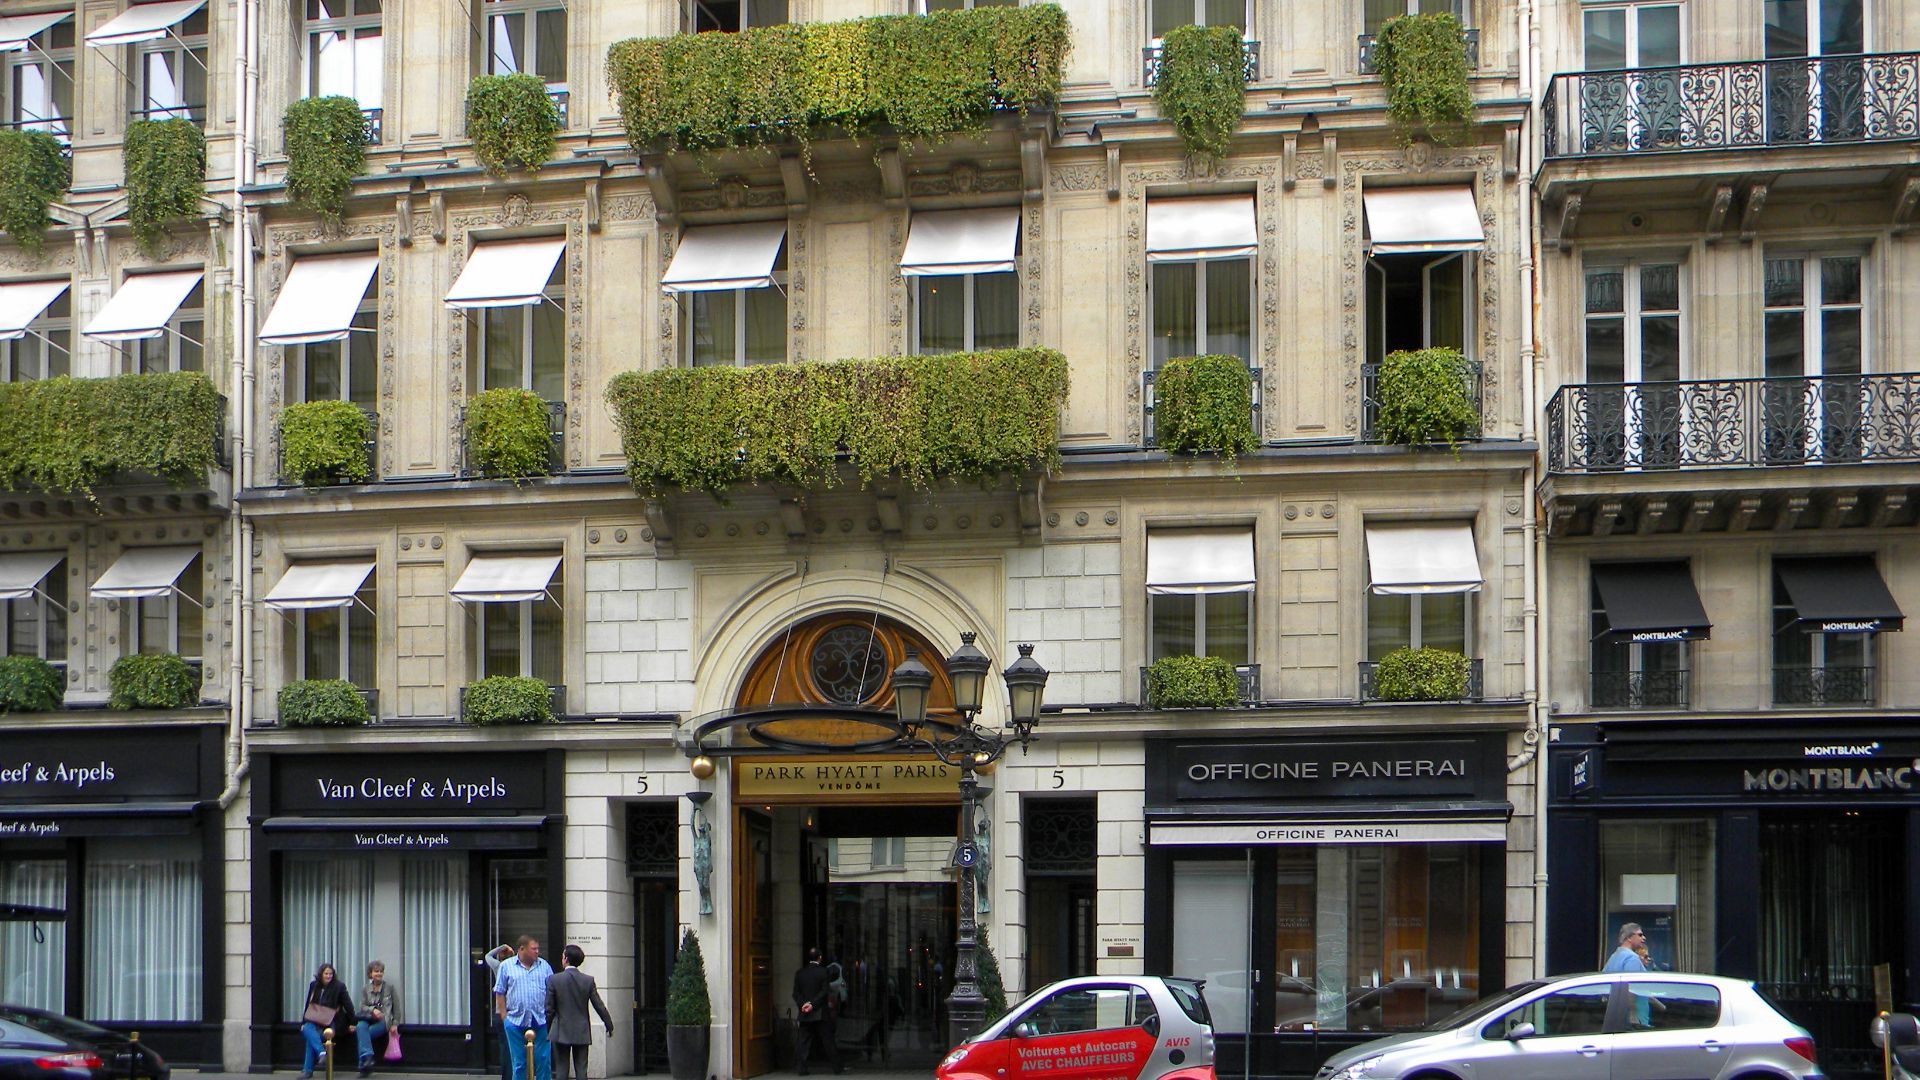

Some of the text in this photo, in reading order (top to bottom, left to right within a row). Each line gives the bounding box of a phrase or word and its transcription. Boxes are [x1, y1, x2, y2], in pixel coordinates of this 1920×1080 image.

[1822, 621, 1874, 631] MONTBLANC
[1632, 630, 1683, 641] MONTBLANC
[1804, 745, 1873, 757] MONTBLANC
[0, 761, 115, 787] eef & Arpels
[754, 764, 948, 780] PARK HYATT PARIS
[1188, 759, 1466, 781] OFFICINE PANERAI
[637, 775, 648, 795] 5
[818, 781, 882, 790] VENDÔME
[1052, 769, 1065, 789] 5
[1744, 767, 1912, 791] MONTBLANC
[317, 776, 506, 804] Van Cleef & Arpels
[0, 821, 60, 837] leef & Arpels
[1256, 828, 1399, 840] OFFICINE PANERAI
[355, 832, 449, 848] Van Cleef & Arpels
[963, 848, 972, 862] 5
[1018, 1040, 1137, 1058] Voitures et Autocars
[1165, 1037, 1190, 1048] AVIS
[1021, 1052, 1135, 1071] AVEC CHAUFFEURS
